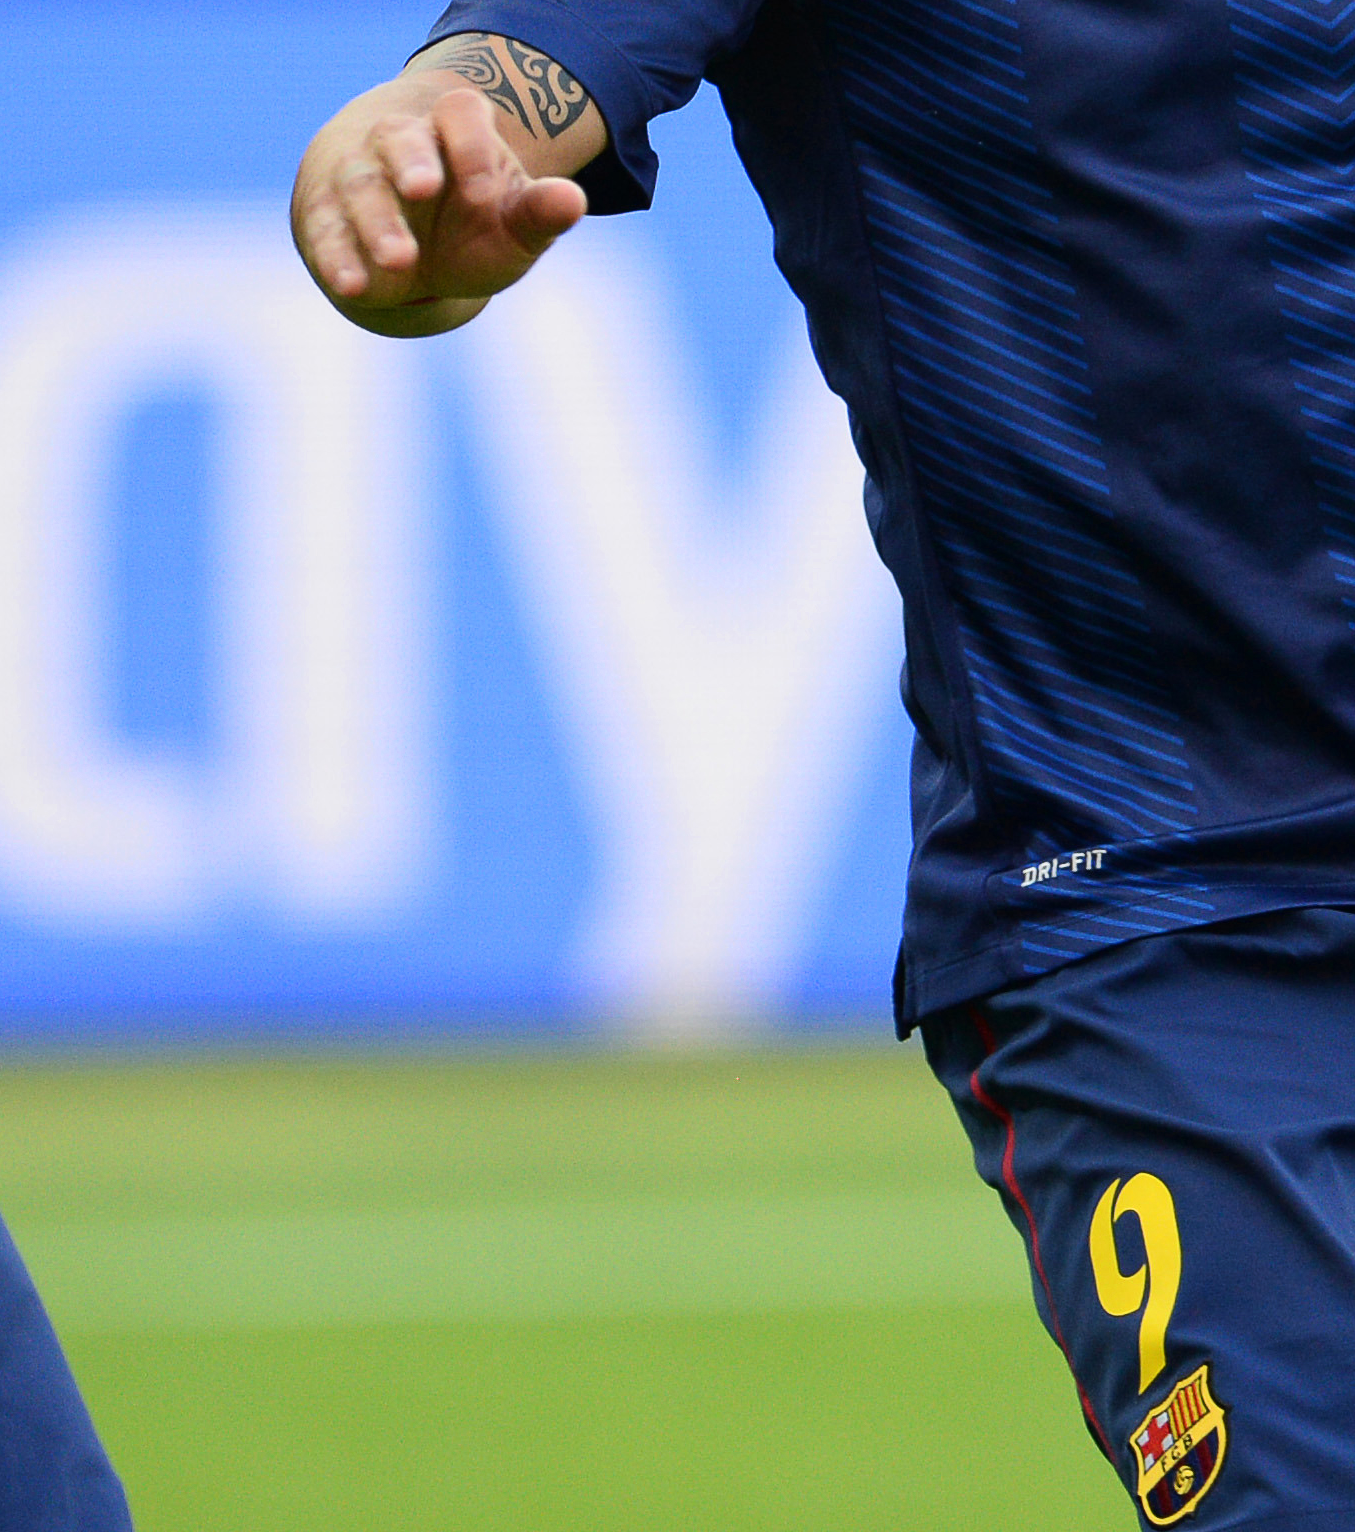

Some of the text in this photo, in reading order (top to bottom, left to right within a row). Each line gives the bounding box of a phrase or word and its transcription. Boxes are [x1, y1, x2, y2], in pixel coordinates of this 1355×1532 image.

[1020, 849, 1108, 888] DRI-FIT
[1089, 1172, 1183, 1396] 9
[1161, 1434, 1193, 1473] FCB
